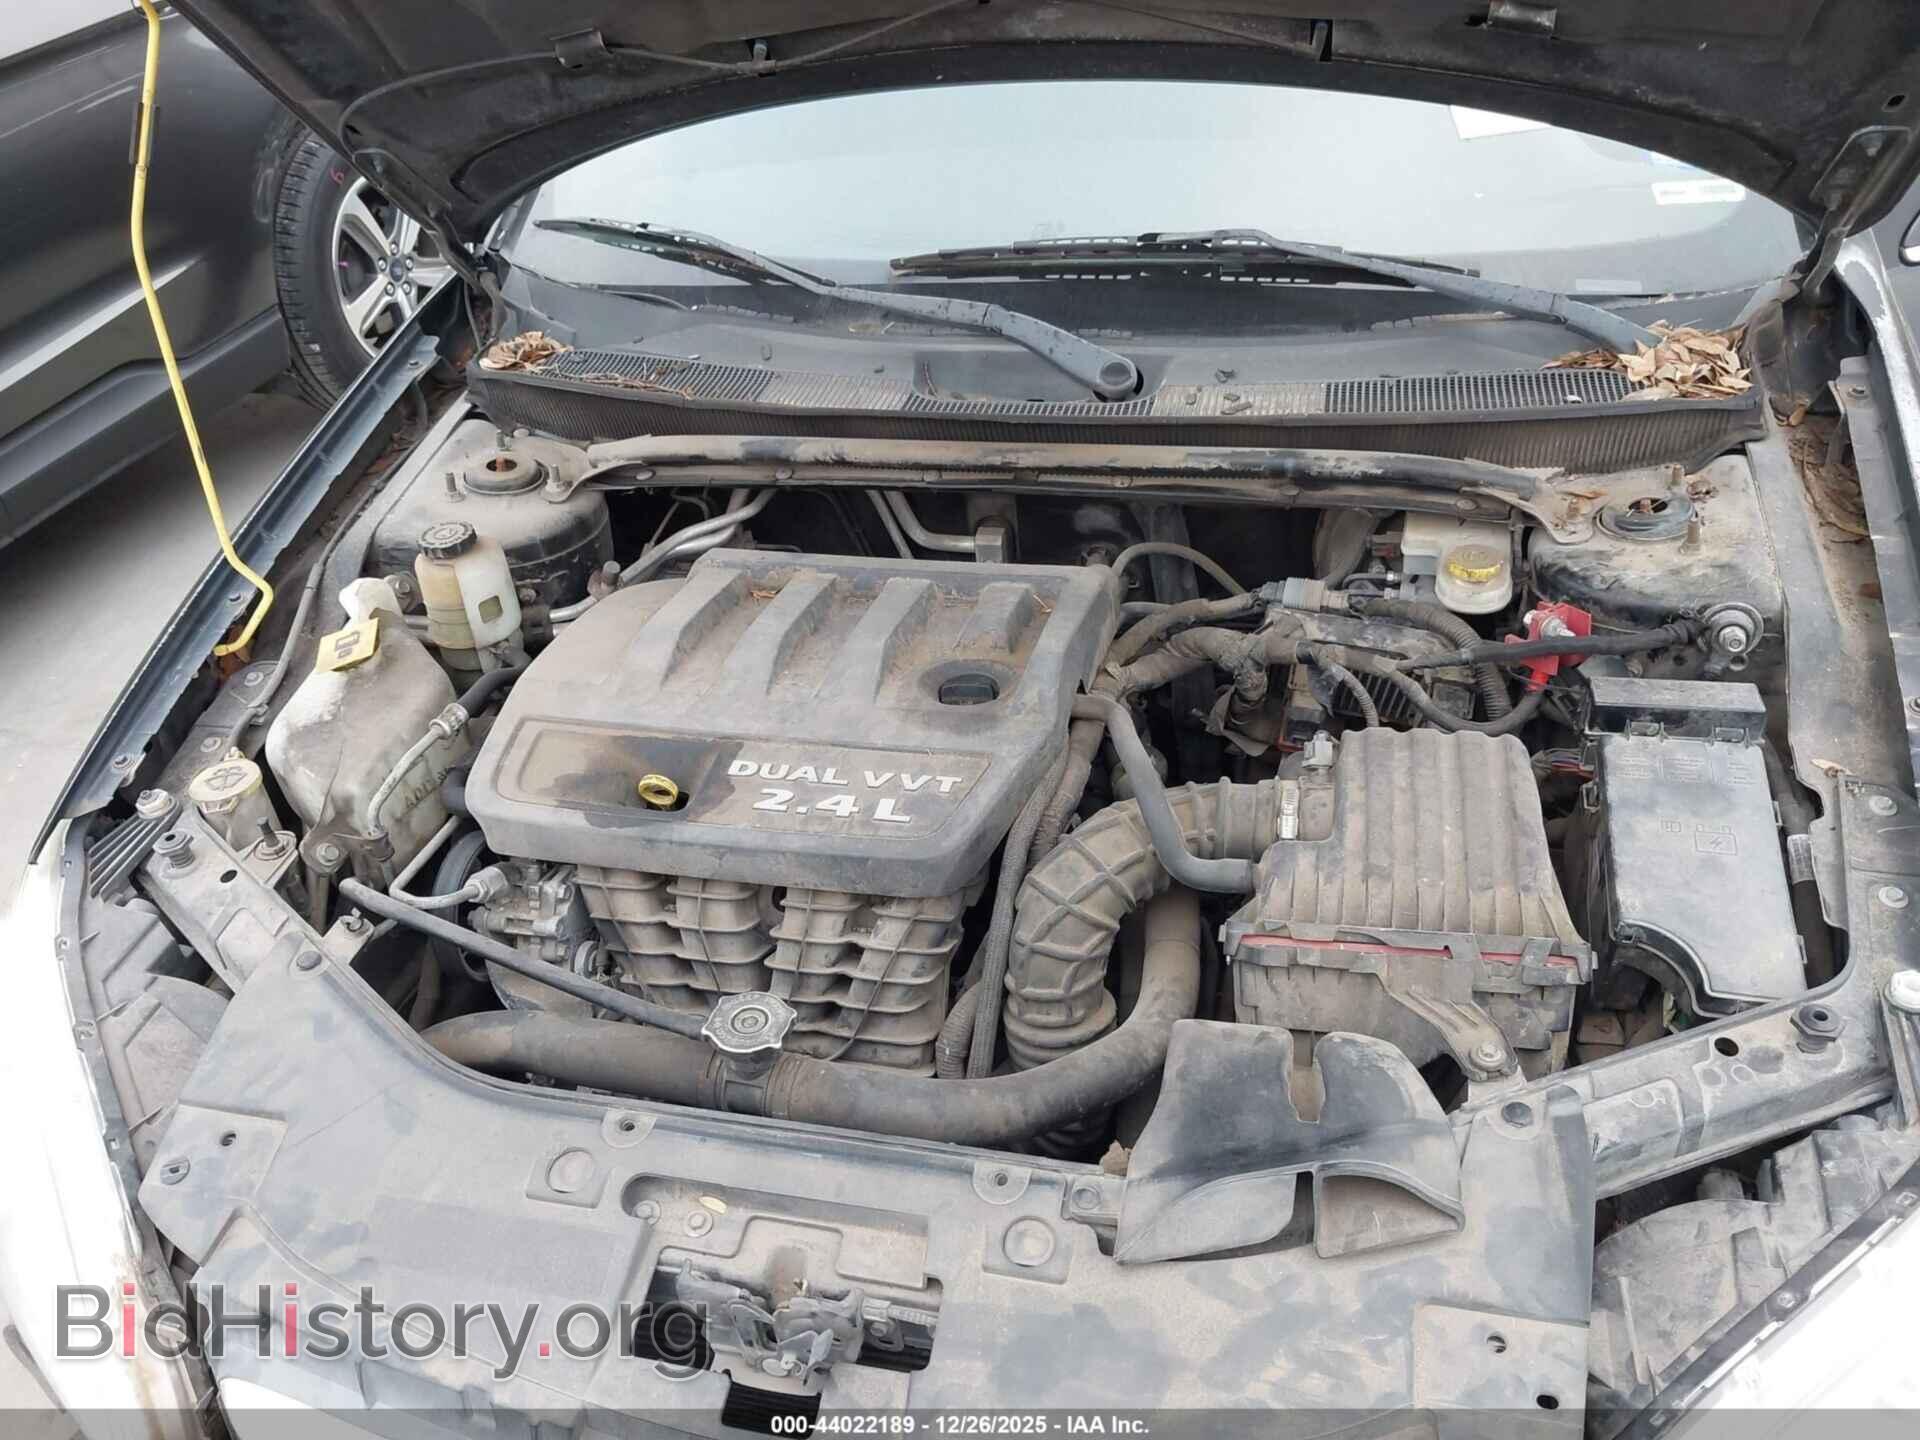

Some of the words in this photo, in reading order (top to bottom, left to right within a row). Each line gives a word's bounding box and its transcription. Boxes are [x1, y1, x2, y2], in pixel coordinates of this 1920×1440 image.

[727, 759, 849, 786] DUAL
[863, 770, 963, 793] VVT
[752, 788, 861, 818] 2.4
